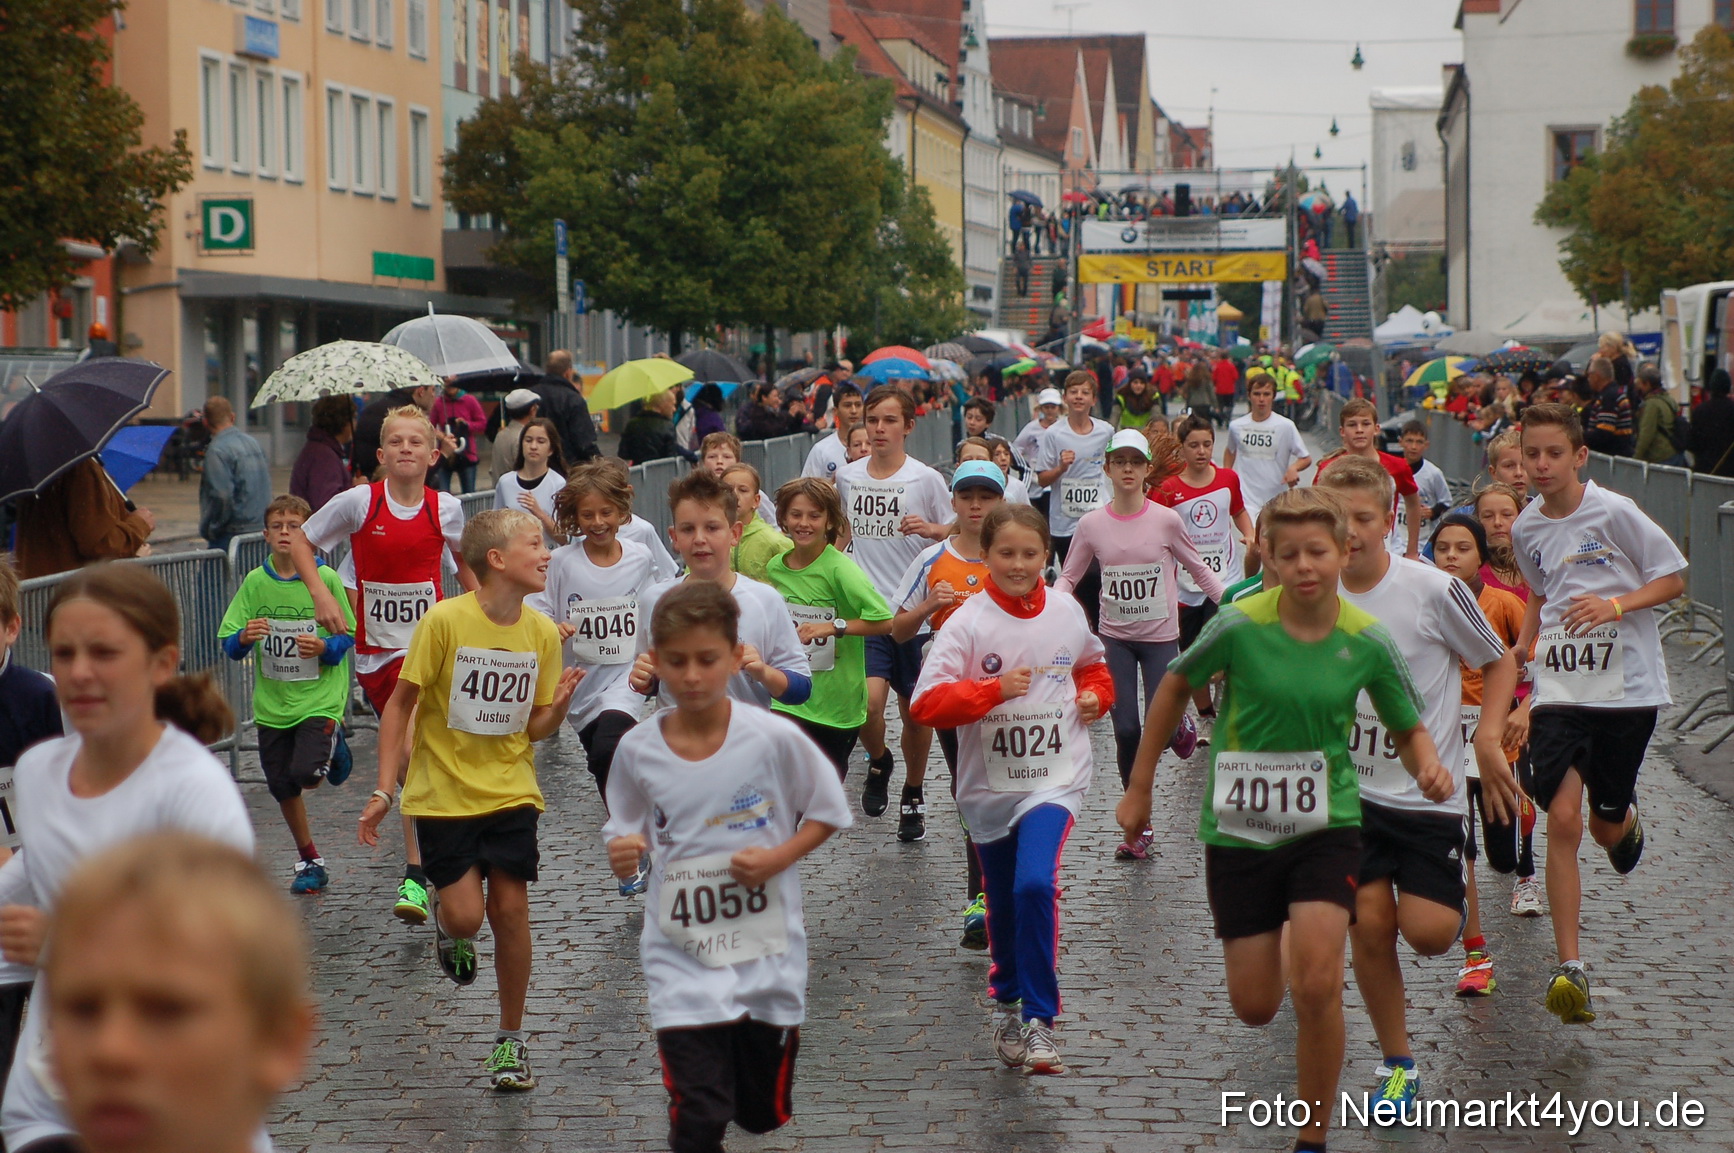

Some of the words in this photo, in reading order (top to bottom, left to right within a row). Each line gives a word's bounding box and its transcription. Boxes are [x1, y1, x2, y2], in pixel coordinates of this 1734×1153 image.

[209, 206, 246, 243] D
[1147, 260, 1217, 278] START
[1242, 433, 1272, 447] 4053
[868, 486, 895, 494] Neumarkt
[1065, 488, 1098, 503] 4002
[853, 494, 900, 517] 4054
[852, 518, 895, 537] Patrick
[1122, 569, 1153, 577] Neumarkt
[364, 587, 386, 596] PARTL
[387, 589, 423, 597] Neumarkt
[1108, 577, 1158, 601] 4007
[370, 598, 428, 623] 4050
[596, 603, 629, 613] Neumarkt
[792, 611, 822, 620] Neumarkt
[1119, 605, 1149, 615] Natalie
[579, 612, 636, 640] 4046
[264, 635, 297, 658] 402
[598, 645, 620, 656] Paul
[457, 655, 488, 666] PARTL
[490, 659, 529, 669] Neumarkt
[1545, 642, 1614, 673] 4047
[460, 669, 531, 703] 4020
[475, 710, 511, 724] Justus
[982, 714, 1011, 723] PARTL
[1013, 711, 1054, 721] Neumarkt
[992, 724, 1063, 758] 4024
[1348, 722, 1399, 760] 019
[1007, 766, 1049, 779] Luciana
[1217, 762, 1252, 772] PARTL
[1254, 762, 1306, 772] Neumarkt
[1225, 776, 1316, 813] 4018
[1246, 818, 1296, 834] Gabriel
[664, 870, 694, 883] PARTL
[697, 868, 732, 879] Neum
[670, 882, 768, 928] 4058
